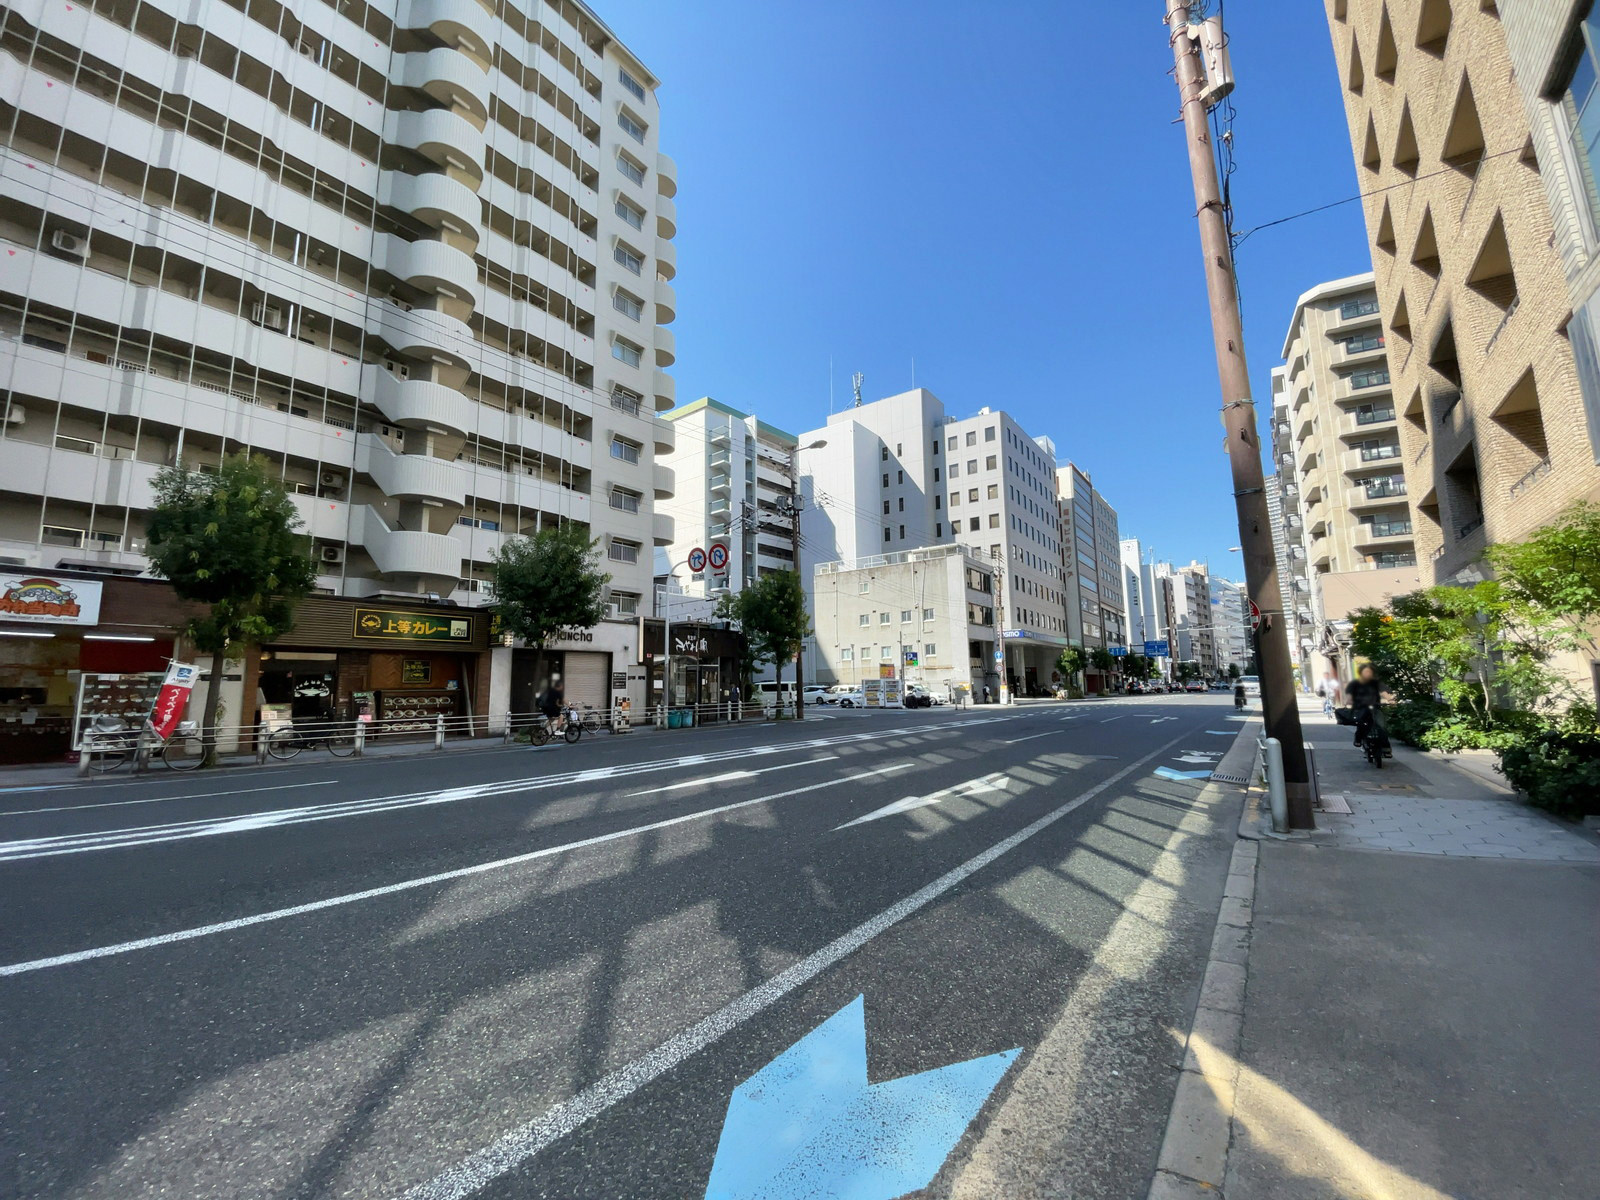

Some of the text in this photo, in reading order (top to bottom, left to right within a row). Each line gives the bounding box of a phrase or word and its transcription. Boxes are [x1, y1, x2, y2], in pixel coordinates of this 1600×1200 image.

[383, 619, 448, 635] 上等カレー
